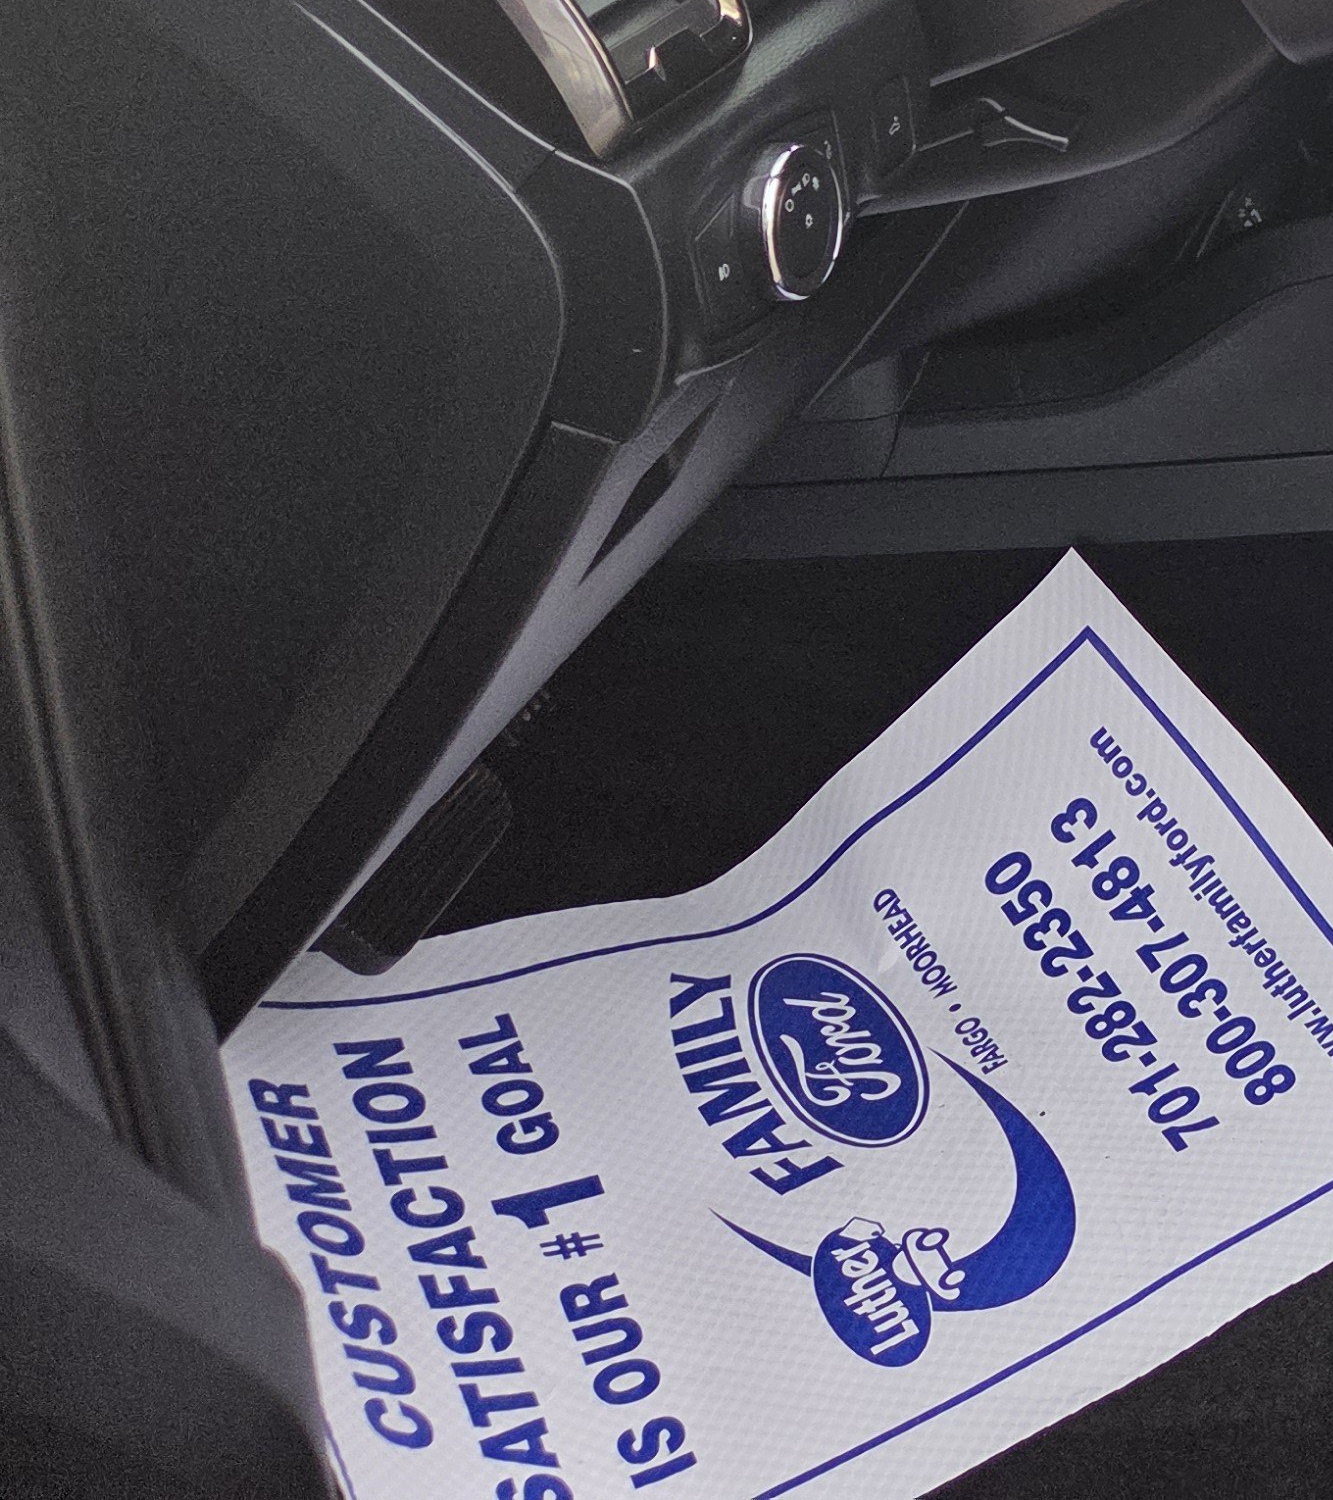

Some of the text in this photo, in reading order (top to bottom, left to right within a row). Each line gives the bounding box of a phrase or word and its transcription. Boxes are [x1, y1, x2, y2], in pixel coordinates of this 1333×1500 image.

[873, 888, 1009, 1075] FARGO MOORHEAD
[984, 851, 1220, 1153] 701-282-2350
[1050, 797, 1297, 1106] 800-307-4813
[458, 1012, 560, 1156] GOAL
[669, 972, 845, 1196] FAMILY
[780, 991, 901, 1107] Ford
[249, 1077, 434, 1448] CUSTOMER
[558, 1272, 661, 1405] OUR
[831, 1239, 920, 1355] Luther
[616, 1416, 697, 1489] IS
